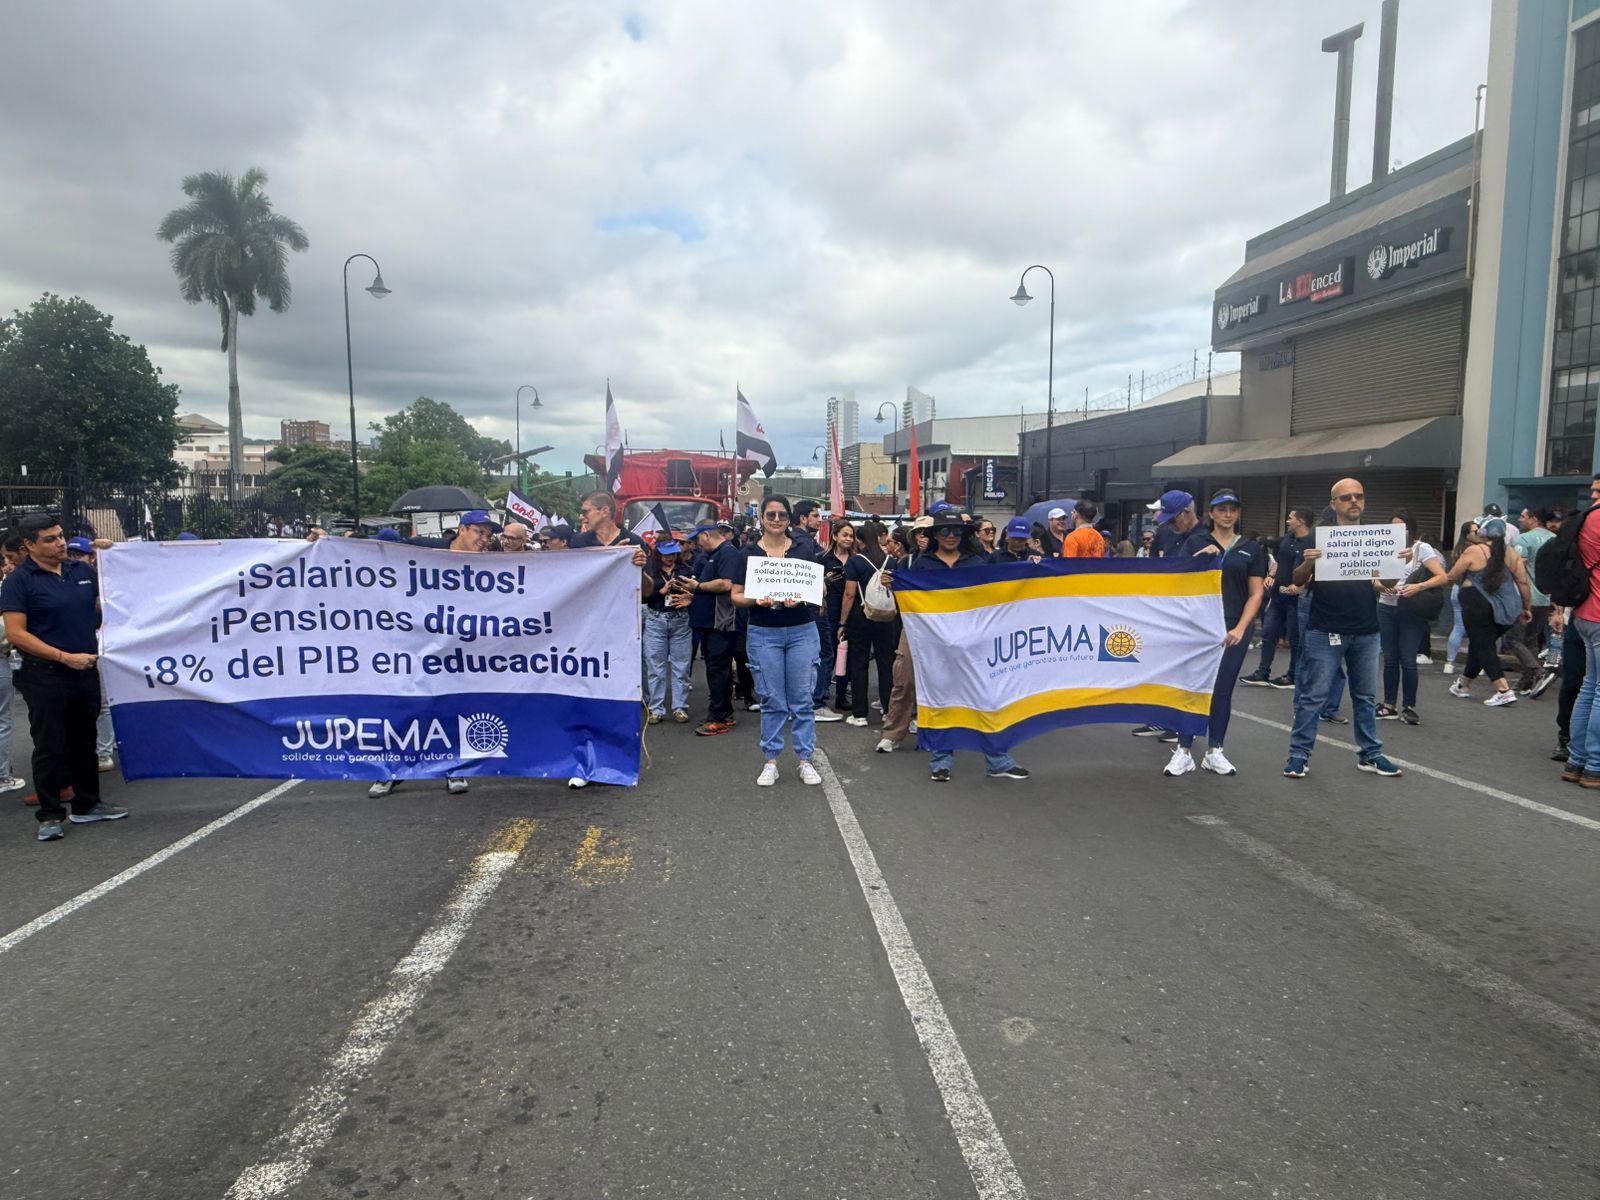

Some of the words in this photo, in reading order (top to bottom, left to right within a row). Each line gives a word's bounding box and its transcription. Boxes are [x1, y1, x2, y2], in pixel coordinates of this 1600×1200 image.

[1388, 228, 1438, 268] Imperial
[1279, 281, 1293, 305] LA
[1229, 295, 1260, 323] Imperial
[1329, 529, 1391, 538] ¡Incremento
[1326, 539, 1362, 548] salarial
[1365, 538, 1395, 547] digno
[1326, 551, 1349, 559] para
[1362, 549, 1394, 557] sector
[794, 563, 812, 571] país
[1340, 559, 1380, 569] público!
[238, 557, 397, 597] ¡Salarios
[405, 559, 525, 597] justos!
[754, 568, 794, 576] solidario,
[795, 570, 817, 579] justo
[1340, 569, 1371, 577] JUPEMA
[783, 577, 813, 586] futuro!
[211, 602, 413, 643] ¡Pensiones
[423, 605, 553, 642] dignas!
[986, 624, 1094, 668] JUPEMA
[143, 654, 214, 688] ¡8%
[227, 646, 285, 679] del
[298, 645, 360, 675] PIB
[372, 651, 412, 674] en
[422, 646, 609, 679] educación!
[282, 718, 452, 750] JUPEMA
[282, 752, 321, 761] solidez
[325, 753, 346, 763] que
[348, 752, 401, 764] garantiza
[419, 752, 454, 761] futuro
